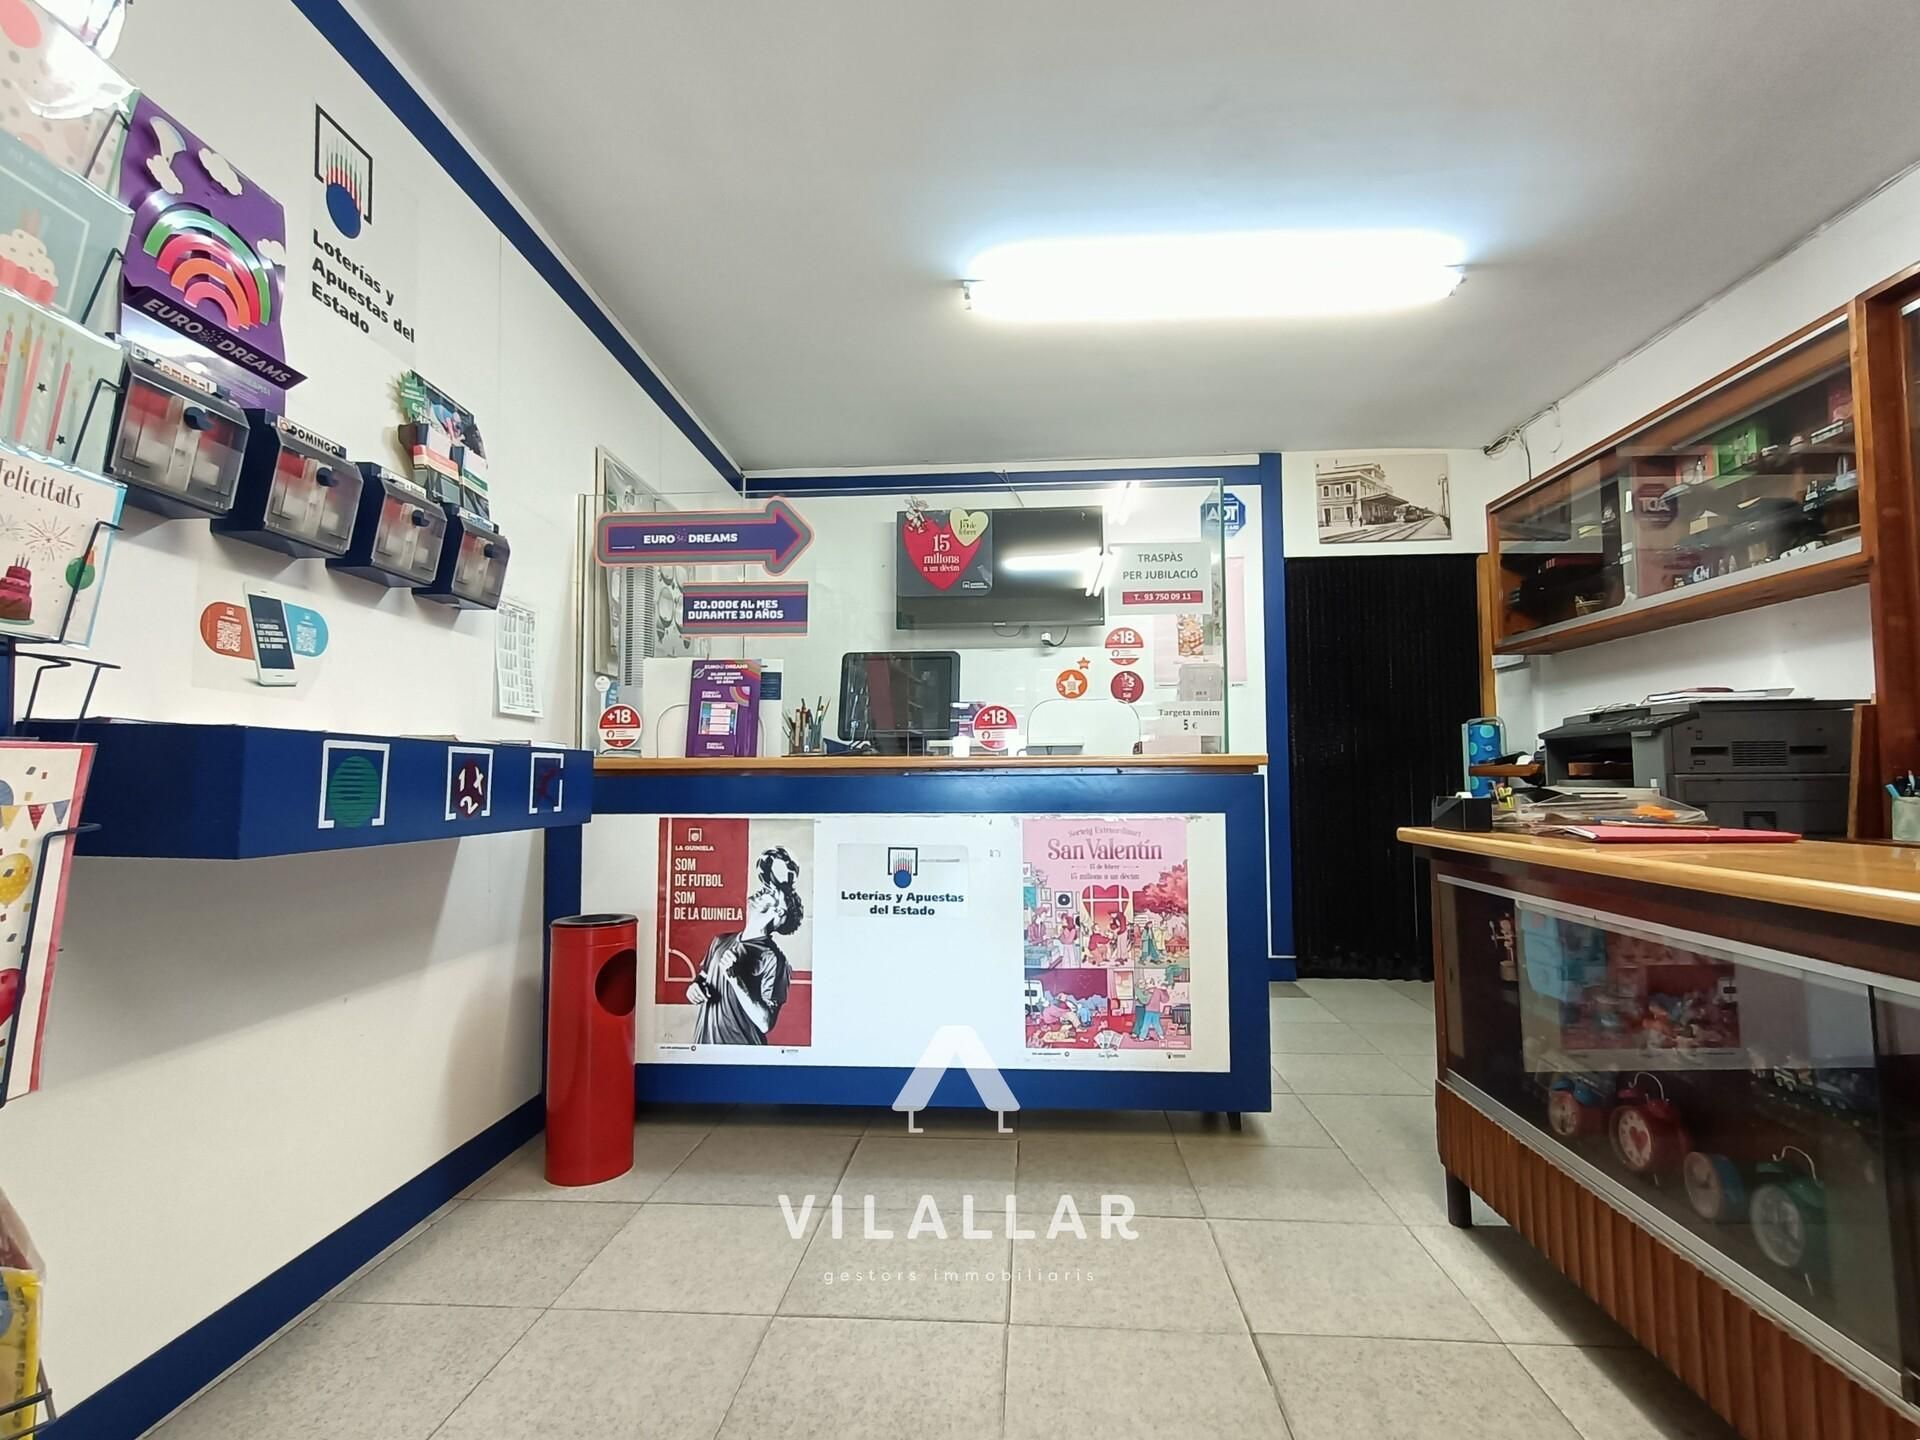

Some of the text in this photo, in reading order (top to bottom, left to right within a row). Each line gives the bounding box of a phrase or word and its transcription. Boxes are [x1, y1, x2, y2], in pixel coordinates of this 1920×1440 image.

[313, 228, 395, 306] Loterías y
[312, 257, 415, 343] Apuestas del
[312, 280, 369, 334] Estado
[143, 298, 291, 383] EURO DREAMS
[290, 424, 338, 455] DOMINGO
[643, 533, 738, 544] EURO DREAMS
[933, 534, 951, 552] 15
[1137, 552, 1184, 563] TRASPÀS
[1123, 567, 1199, 580] PER JUBILACIÓ
[1144, 593, 1154, 601] 93
[1156, 593, 1170, 601] 750
[1171, 593, 1181, 601] 09
[740, 600, 755, 609] AL
[756, 600, 778, 609] MES
[688, 608, 784, 620] DURANTE 30 AÑOS
[1111, 630, 1135, 644] +18
[607, 708, 632, 724] +18
[982, 709, 1008, 725] +18
[1158, 708, 1191, 718] Targeta
[1183, 719, 1199, 730] 5 €
[1047, 837, 1163, 860] San Valentín
[674, 858, 696, 871] SOM
[674, 874, 723, 887] DE FUTBOL
[674, 891, 695, 904] SOM
[841, 890, 964, 904] Loterías y Apuestas
[673, 907, 744, 920] DE LA QUINIELA
[869, 905, 936, 916] del Estado
